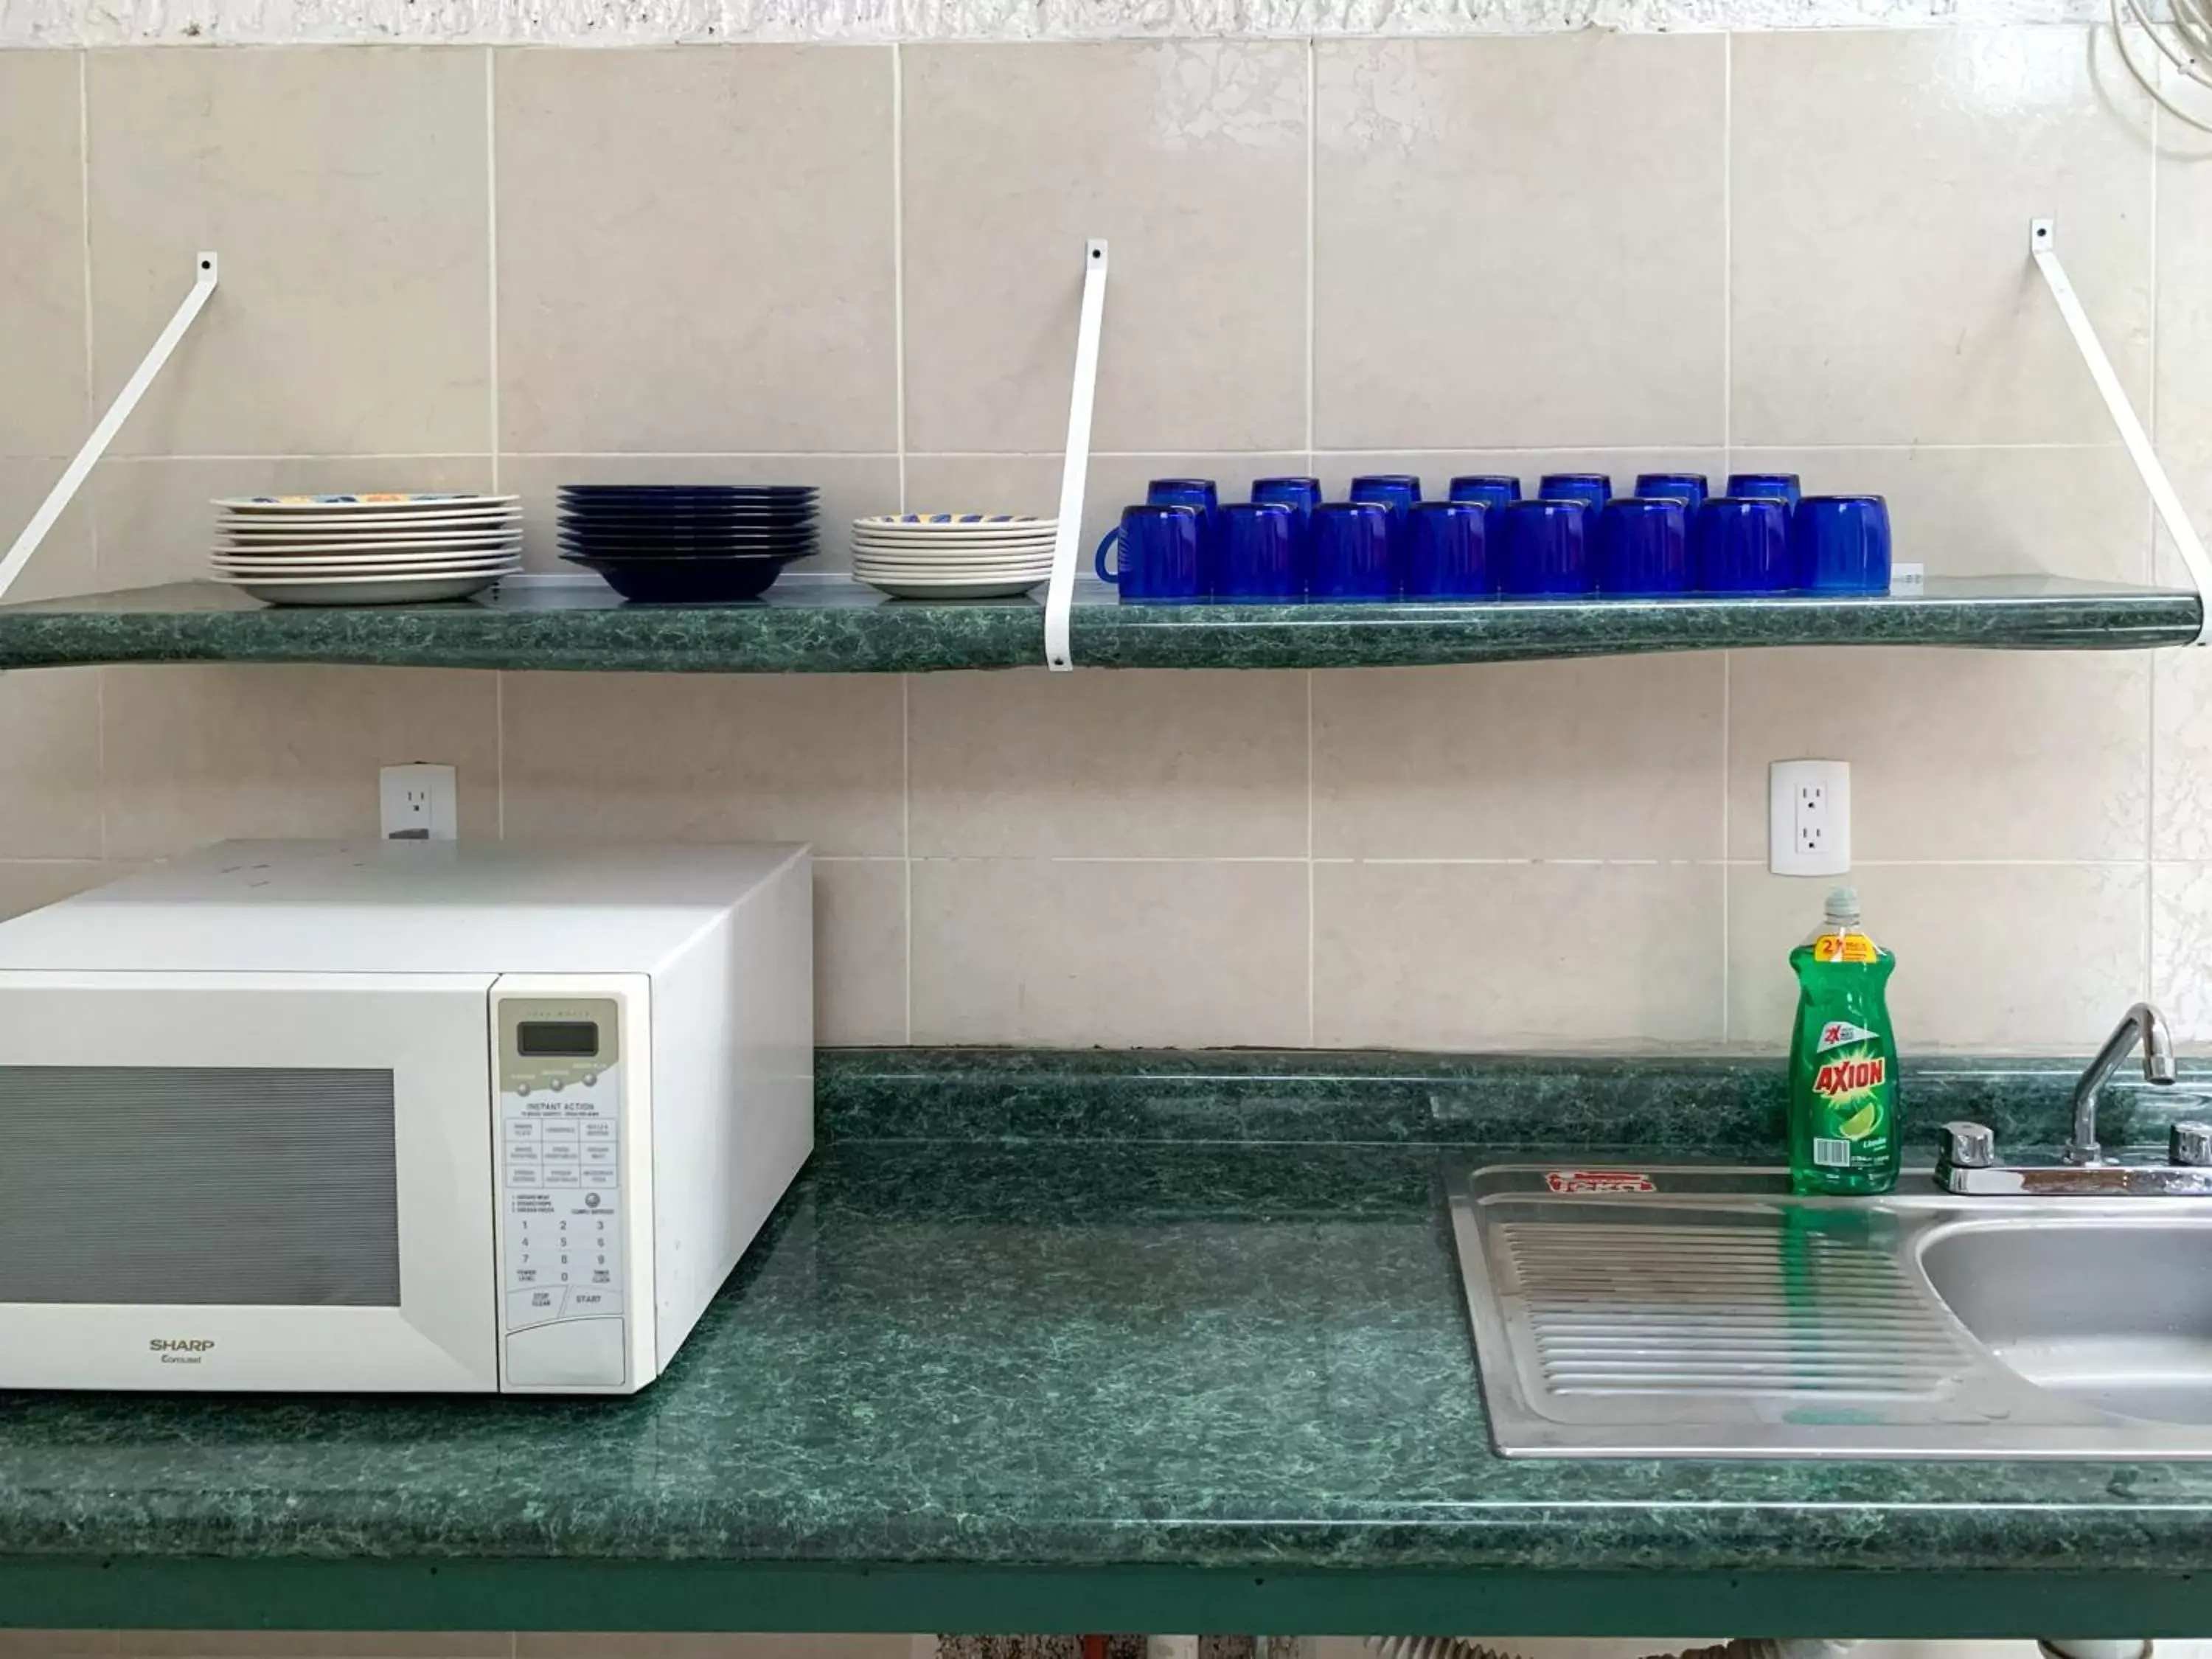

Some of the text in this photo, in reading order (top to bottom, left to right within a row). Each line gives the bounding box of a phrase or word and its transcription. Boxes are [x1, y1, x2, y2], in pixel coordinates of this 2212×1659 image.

[1815, 1060, 1882, 1095] AXION
[522, 1220, 528, 1230] 1
[560, 1220, 567, 1231] 2
[597, 1221, 604, 1231] 3
[521, 1237, 529, 1247] 4
[560, 1237, 567, 1247] 5
[597, 1237, 605, 1248] 6
[522, 1254, 529, 1263] 7
[561, 1255, 567, 1265] 8
[597, 1254, 605, 1265] 9
[561, 1273, 568, 1281] 0
[149, 1340, 215, 1351] SHARP
